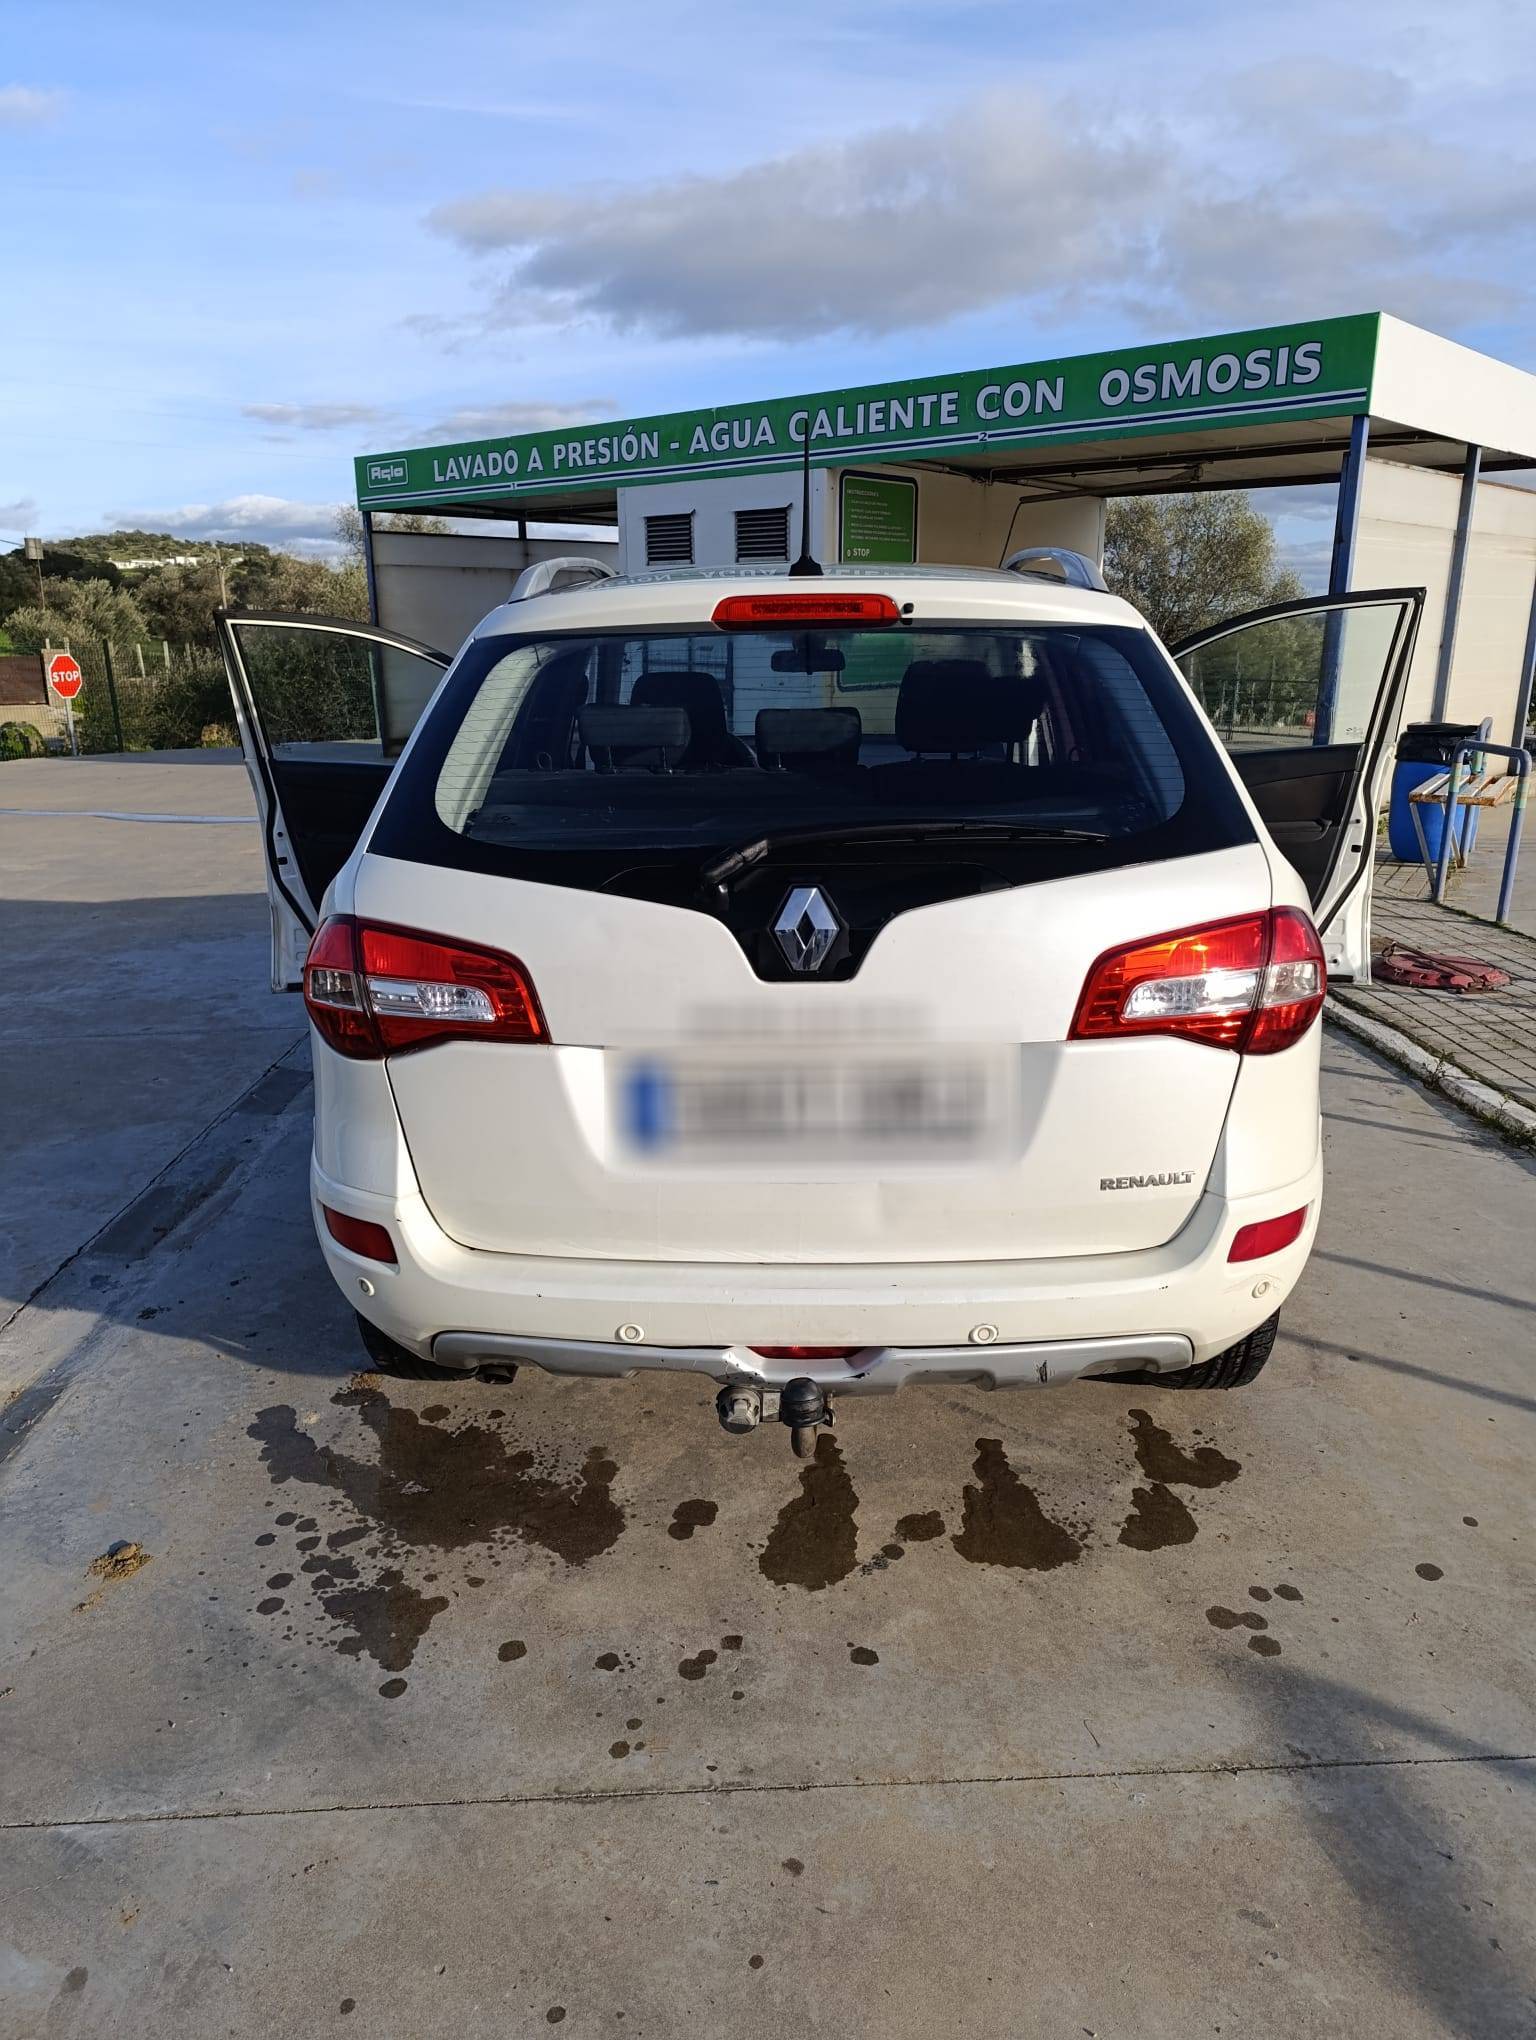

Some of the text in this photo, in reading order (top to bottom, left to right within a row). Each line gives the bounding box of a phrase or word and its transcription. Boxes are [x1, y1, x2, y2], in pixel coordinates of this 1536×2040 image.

[433, 449, 519, 482] LAVADO
[527, 447, 543, 471] A
[553, 426, 659, 470] PRESIÓN
[688, 416, 776, 454] AGUA
[788, 391, 959, 442] CALIENTE
[976, 377, 1064, 420] CON
[1099, 342, 1323, 407] OSMOSIS
[979, 432, 988, 441] 2
[853, 547, 870, 557] STOP
[52, 671, 80, 683] STOP
[1099, 1171, 1196, 1192] RENAULT
